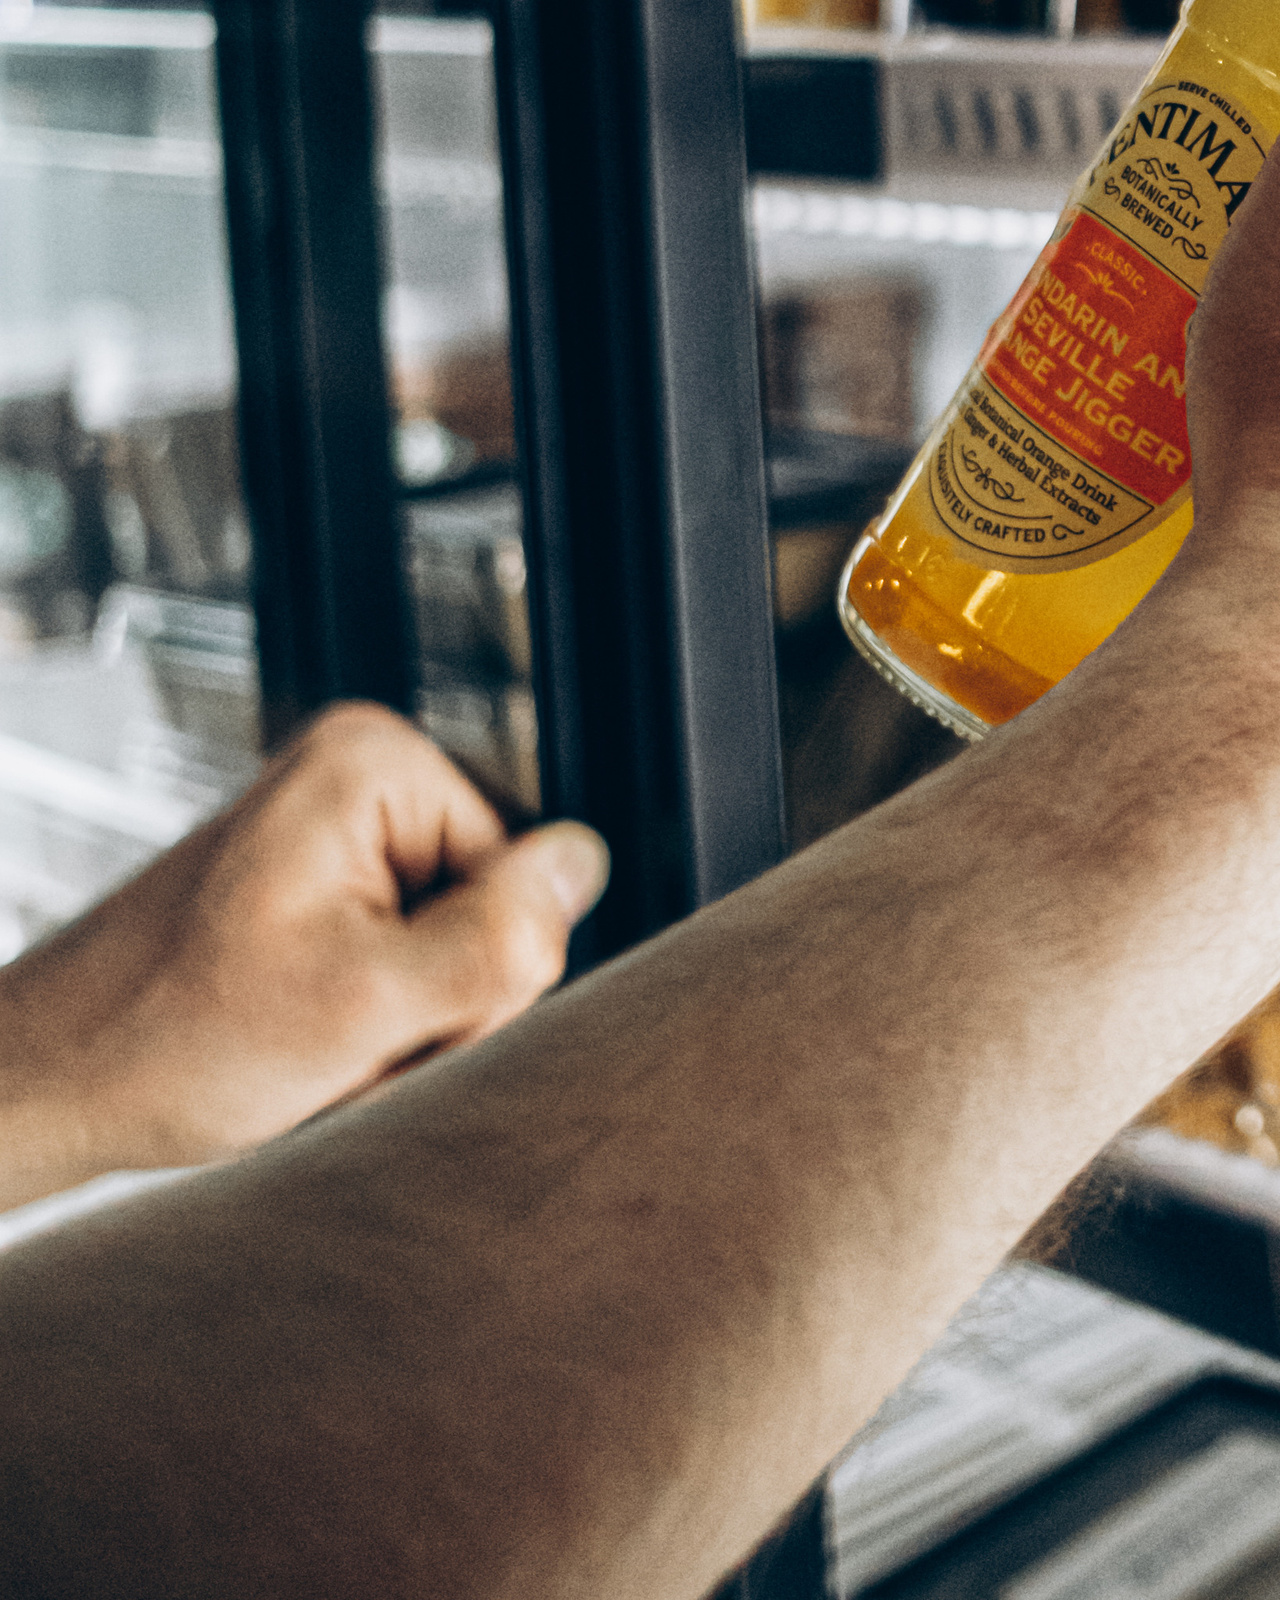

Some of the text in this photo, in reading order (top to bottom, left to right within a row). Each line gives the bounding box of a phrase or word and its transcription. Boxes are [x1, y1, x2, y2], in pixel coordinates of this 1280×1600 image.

[1177, 81, 1252, 136] SERVE CHILLED
[1089, 102, 1253, 228] ENTIMA
[1121, 165, 1204, 232] BOTANICALLY
[1121, 193, 1174, 239] BREWED
[1090, 242, 1145, 290] CLASSIC
[1023, 297, 1135, 402] SEVILLE
[979, 394, 1025, 444] Botanical
[1022, 437, 1071, 481] Orange
[1072, 473, 1119, 512] Drink
[1055, 376, 1185, 474] JIGGER
[988, 433, 999, 449] &
[997, 443, 1042, 484] Herbal
[1039, 477, 1102, 526] Extracts
[974, 516, 1046, 543] CRAFTED
